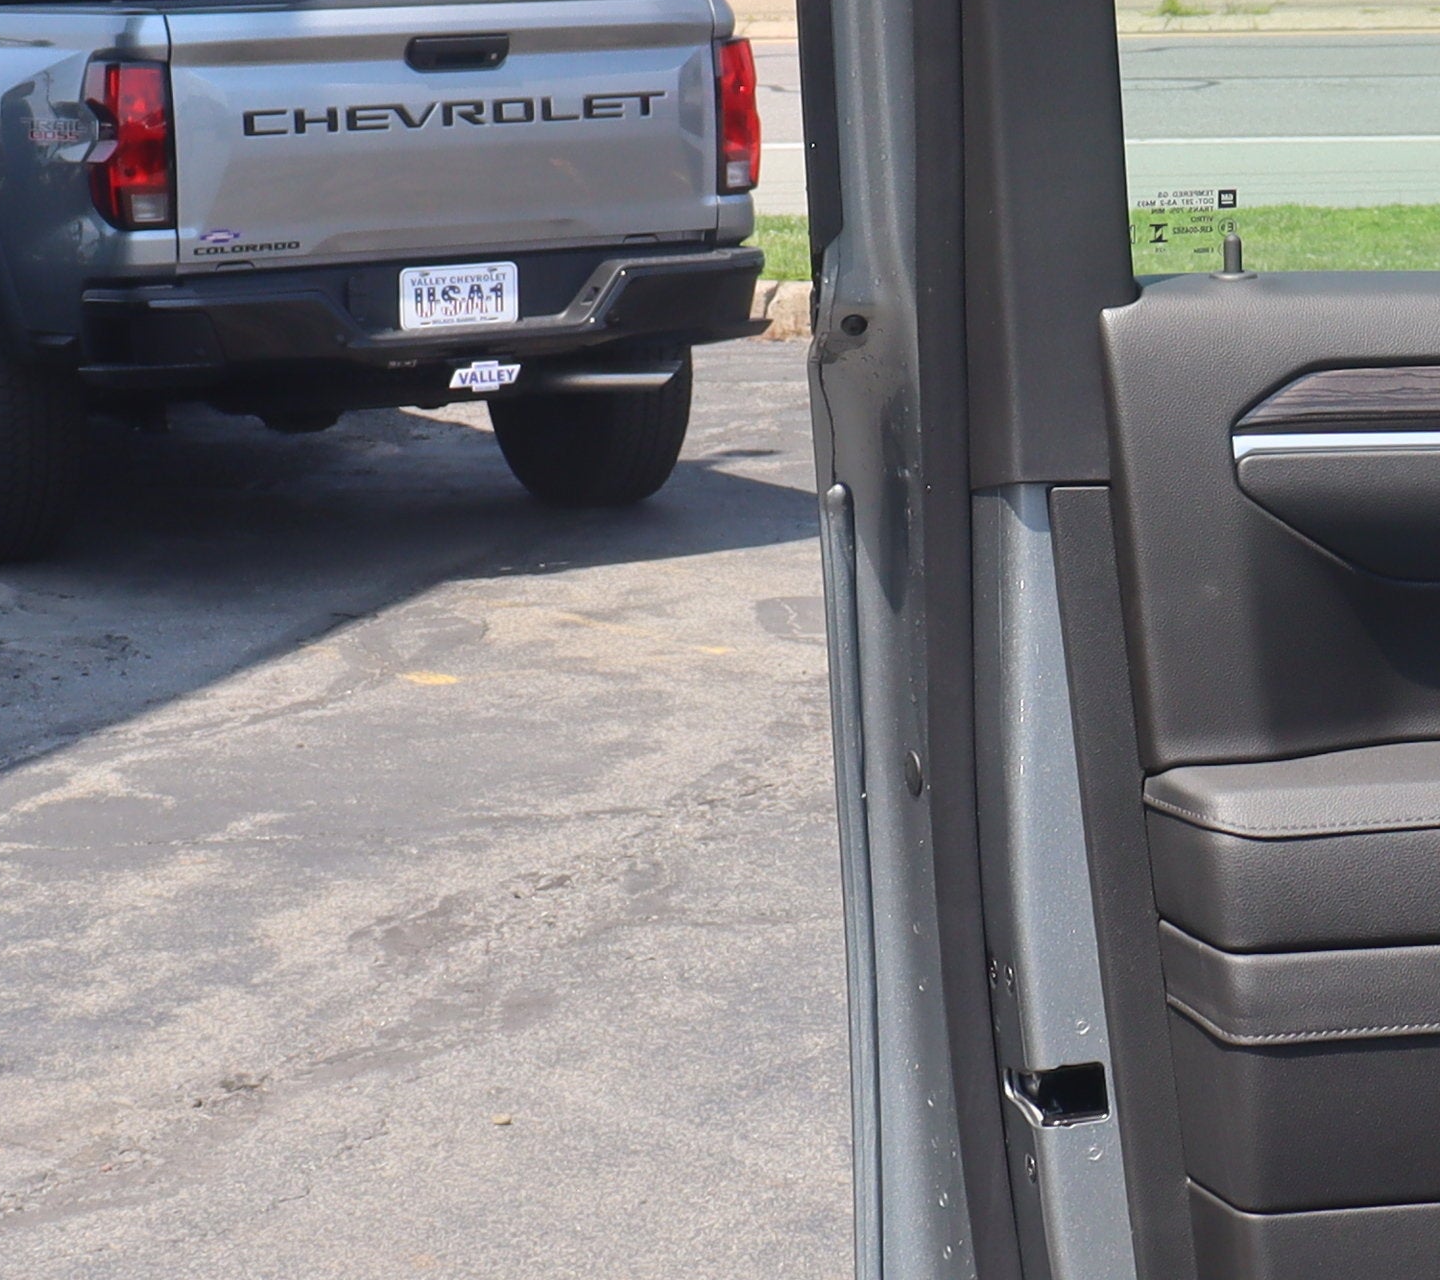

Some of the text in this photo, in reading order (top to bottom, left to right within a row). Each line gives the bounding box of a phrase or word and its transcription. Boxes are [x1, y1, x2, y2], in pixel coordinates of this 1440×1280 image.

[242, 90, 666, 137] CHEVROLET
[193, 240, 300, 256] COLORADO
[410, 272, 507, 287] VALLEY CHEVROLET
[459, 368, 515, 385] VALLEY
